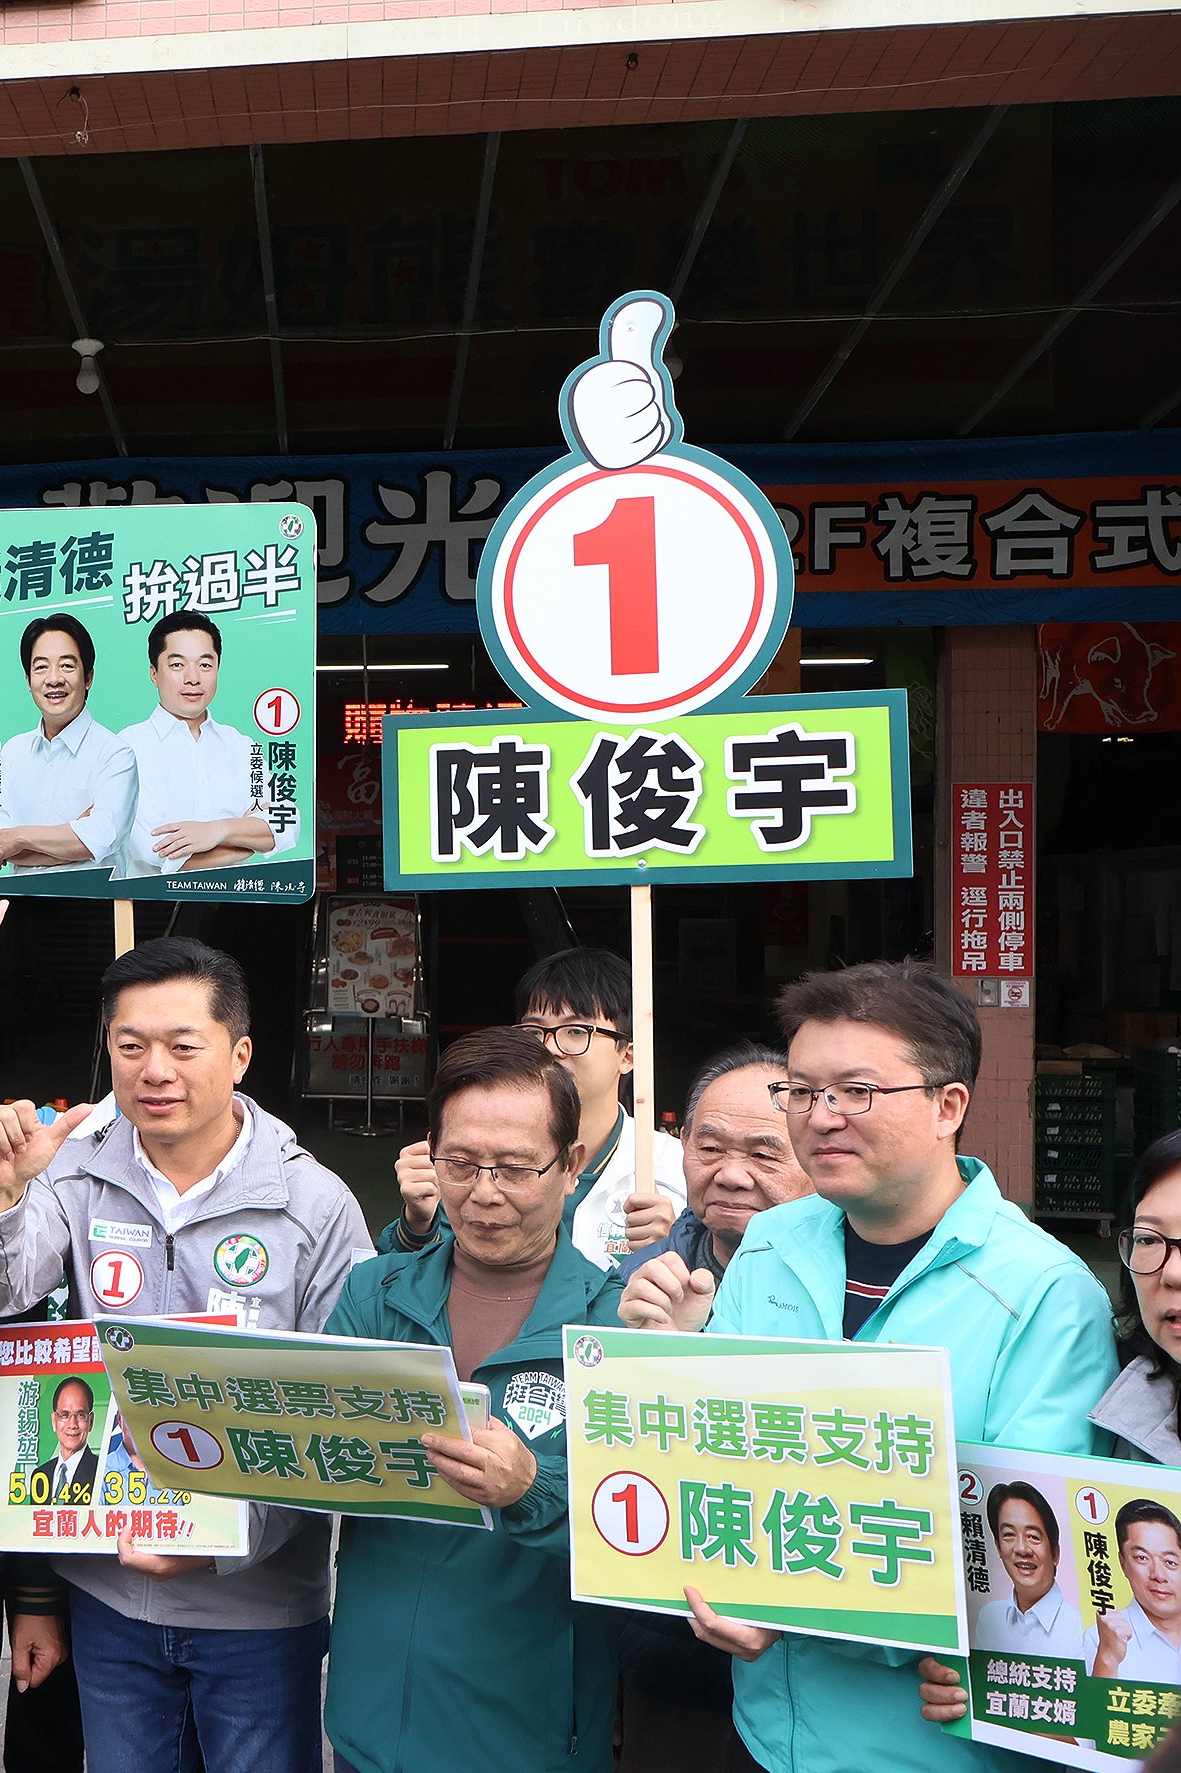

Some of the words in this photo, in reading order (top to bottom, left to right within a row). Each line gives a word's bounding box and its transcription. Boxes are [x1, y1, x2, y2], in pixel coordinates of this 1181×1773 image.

[123, 545, 301, 624] 拚過半
[573, 496, 659, 676] 1
[266, 696, 283, 727] 1
[250, 743, 264, 812] 立委候選人
[268, 742, 297, 833] 陳俊宇
[436, 730, 849, 855] 陳俊宇
[960, 788, 988, 874] 違者報警
[166, 880, 192, 889] TEAM
[193, 881, 227, 890] TAIWAN
[997, 788, 1025, 972] 出入口禁止兩側停車
[960, 887, 988, 972] 逕行拖吊
[110, 1226, 150, 1238] TAIWAN
[102, 1261, 125, 1298] 1
[121, 1366, 447, 1426] 集中選票支持
[512, 1372, 538, 1383] TEAM
[17, 1380, 40, 1464] 游錫堃
[518, 1405, 552, 1425] 2024
[583, 1389, 933, 1476] 集中選票支持
[9, 1472, 91, 1504] 50.4%
[167, 1427, 201, 1462] 1
[225, 1426, 441, 1489] 陳俊宇
[959, 1474, 977, 1500] 2
[32, 1510, 194, 1540] 宜蘭人的期待!!
[611, 1484, 640, 1544] 1
[680, 1480, 933, 1585] 陳俊宇
[1083, 1492, 1097, 1520] 1
[960, 1512, 990, 1594] 賴清德
[1083, 1531, 1116, 1616] 陳俊宇
[986, 1658, 1077, 1694] 總統支持
[985, 1691, 1077, 1726] 宜蘭女婿
